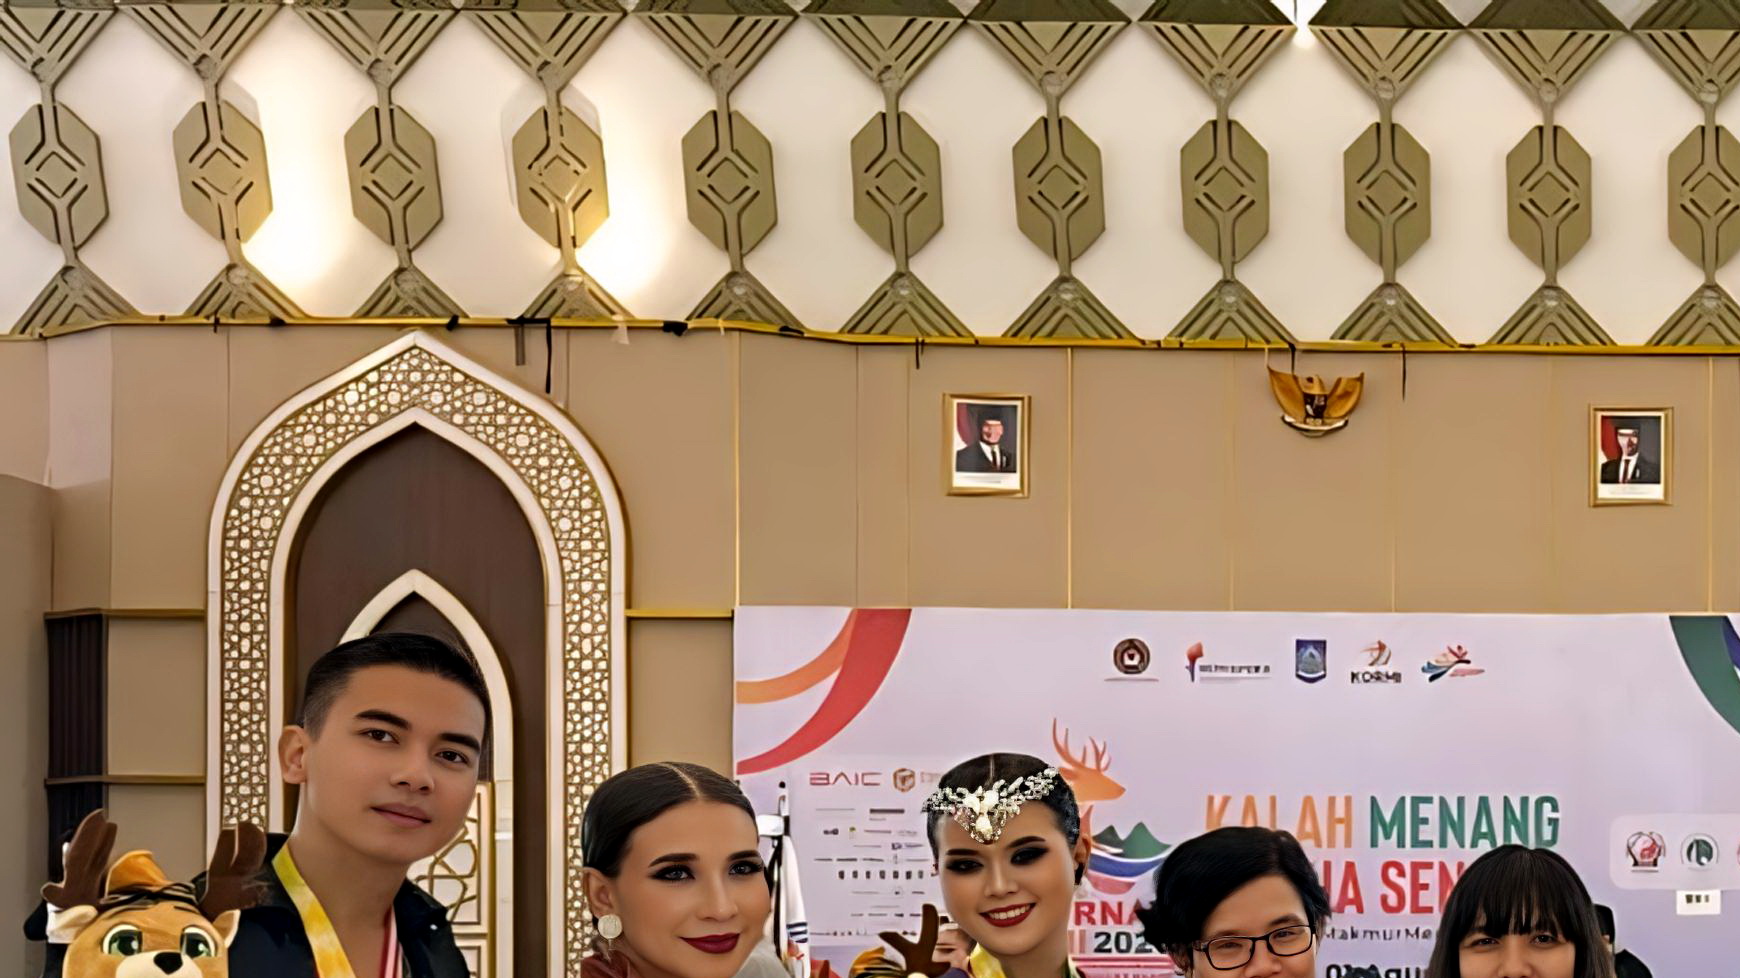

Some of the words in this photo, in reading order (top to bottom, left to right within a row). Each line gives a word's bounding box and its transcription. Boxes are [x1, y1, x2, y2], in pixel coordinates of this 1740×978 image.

[809, 771, 882, 786] BAIC
[1370, 795, 1560, 849] MENANG
[1380, 860, 1464, 914] SEN
[1094, 931, 1152, 954] 202
